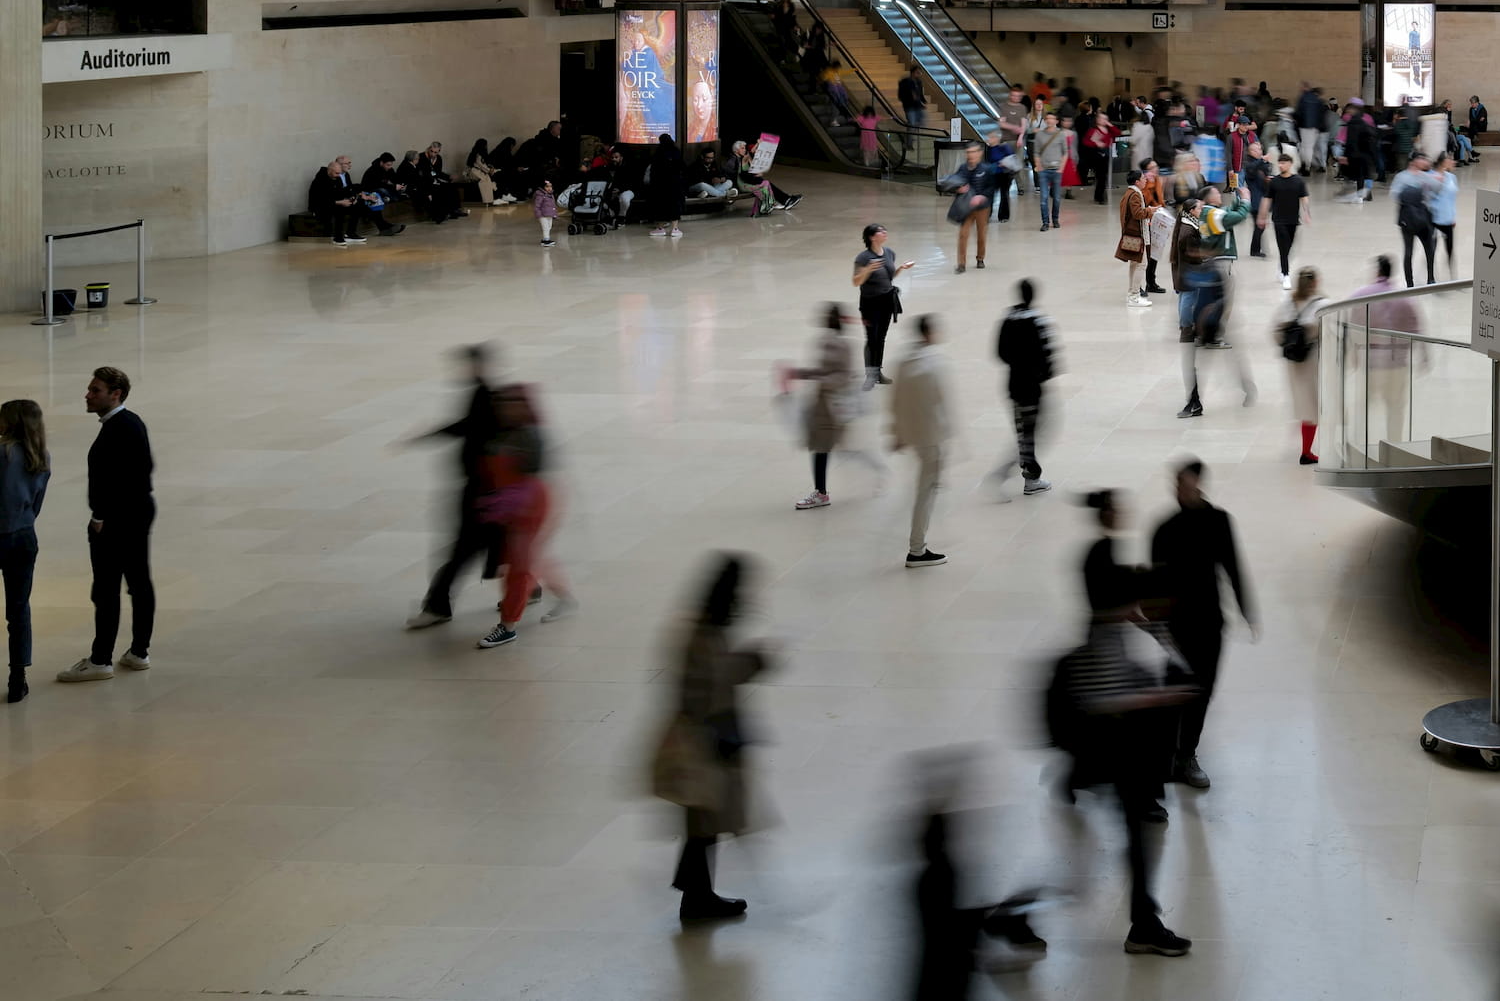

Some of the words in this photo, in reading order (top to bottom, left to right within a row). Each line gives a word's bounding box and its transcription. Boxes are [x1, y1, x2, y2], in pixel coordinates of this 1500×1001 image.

[81, 48, 170, 70] Auditorium
[623, 51, 648, 69] RE
[619, 70, 661, 89] VOIR
[631, 91, 656, 99] EYCK
[1480, 280, 1495, 297] Exit
[1478, 322, 1495, 339] 出口
